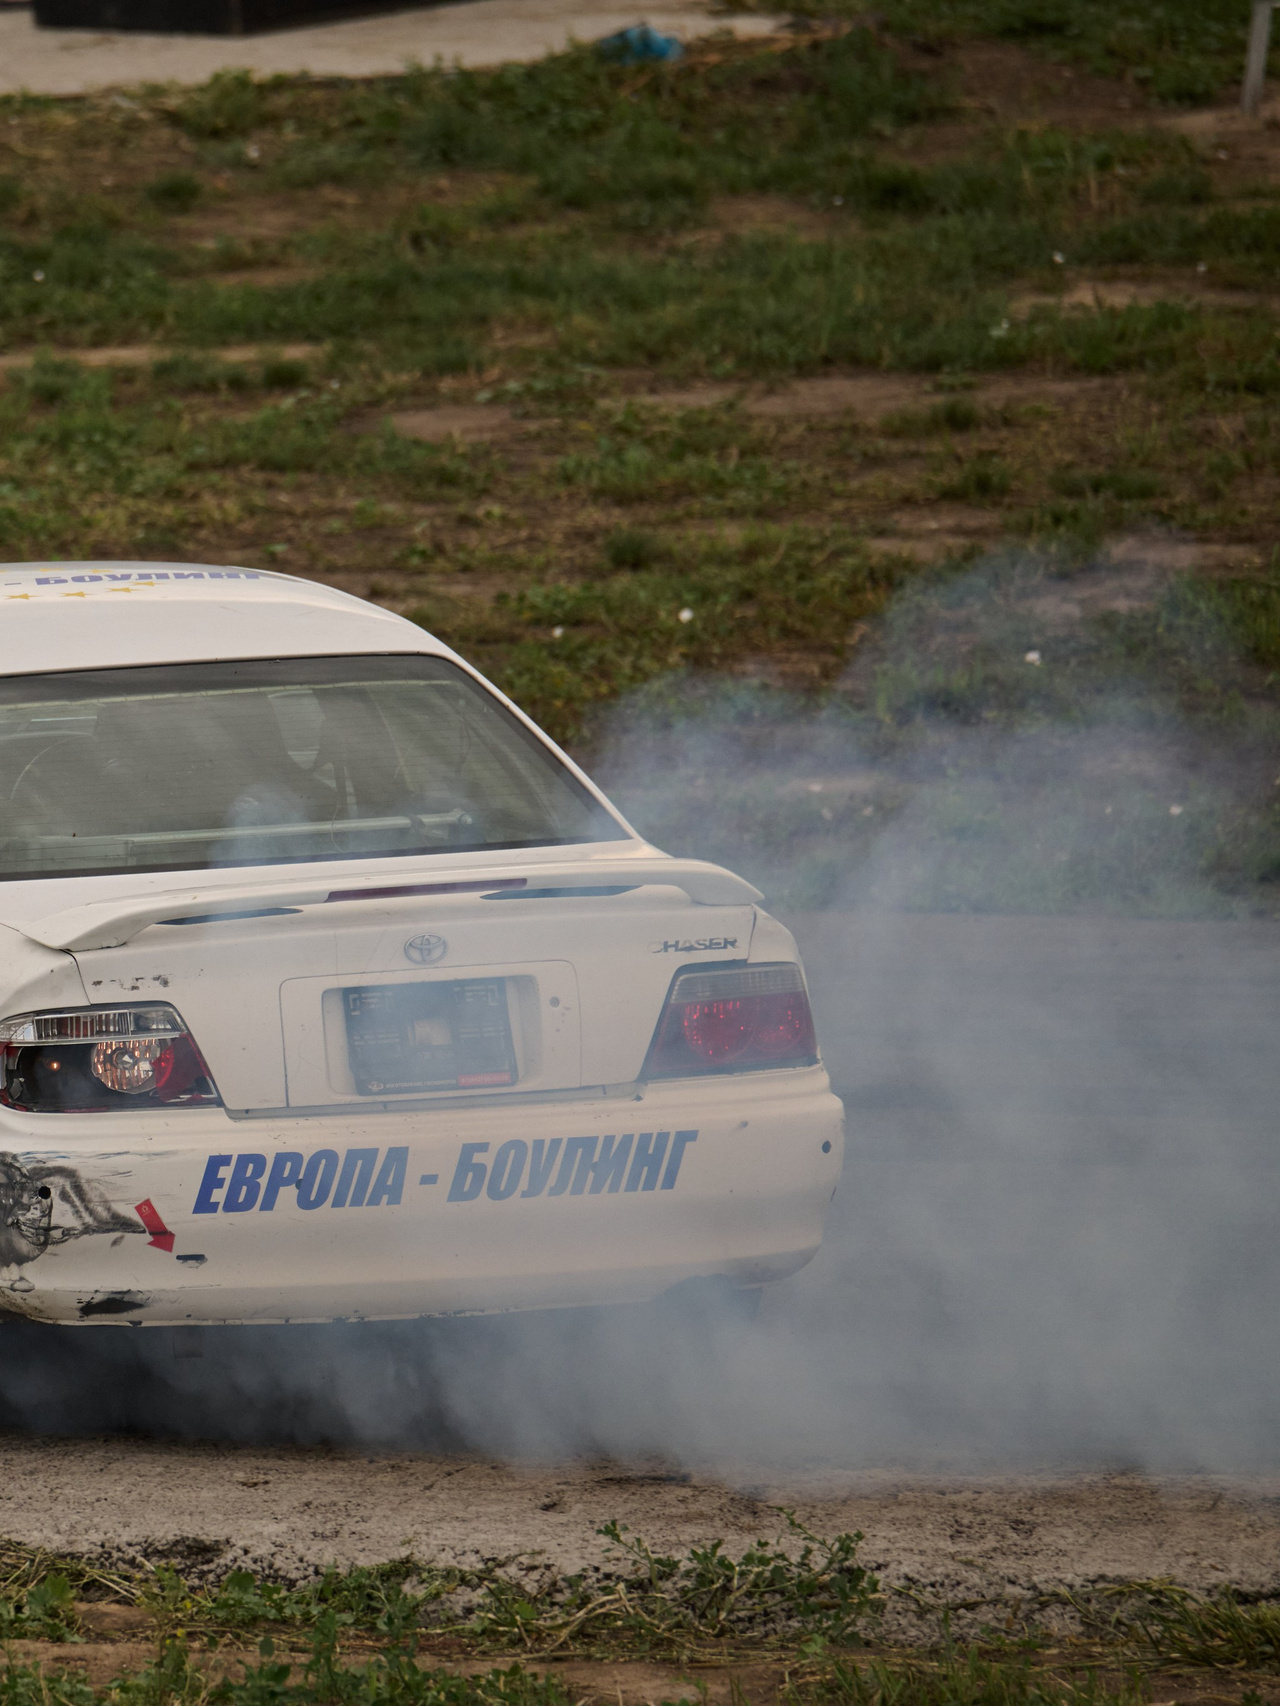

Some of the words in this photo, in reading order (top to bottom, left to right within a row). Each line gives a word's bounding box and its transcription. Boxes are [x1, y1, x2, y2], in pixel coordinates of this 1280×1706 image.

[34, 571, 262, 586] БОУЛИНГ
[647, 937, 740, 953] CHASER
[191, 1146, 410, 1215] ЕВРОПА
[446, 1129, 699, 1204] БОУЛИНГ
